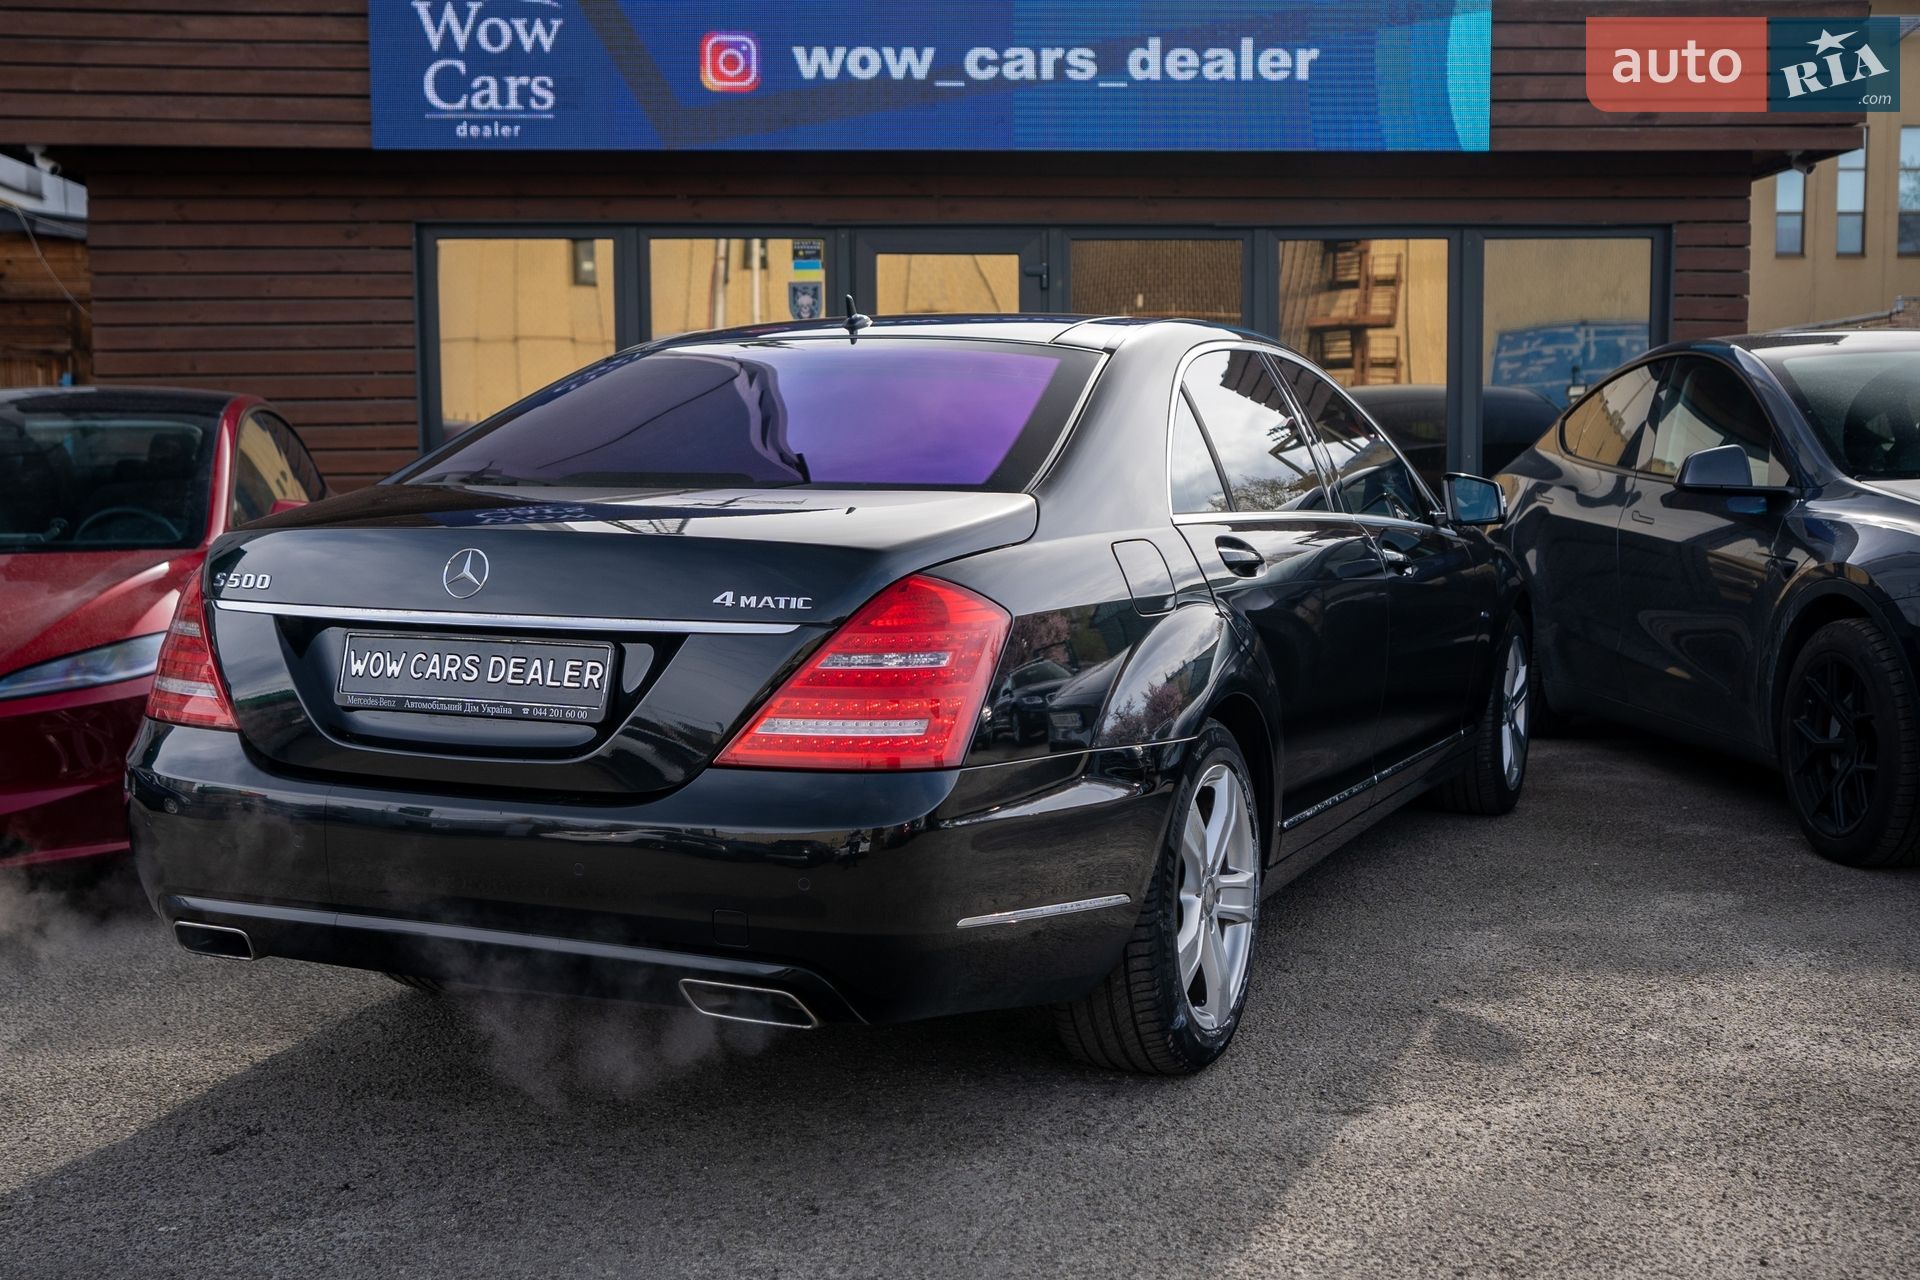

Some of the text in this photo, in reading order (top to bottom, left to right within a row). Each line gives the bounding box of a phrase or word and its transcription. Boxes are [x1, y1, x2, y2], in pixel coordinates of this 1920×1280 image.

[411, 1, 563, 53] Wow
[792, 36, 1320, 88] wow_cars_dealer
[422, 59, 556, 112] Cars
[455, 120, 522, 138] dealer
[349, 649, 604, 690] WOW CARS DEALER
[346, 695, 397, 708] Mercedes-Benz
[463, 702, 479, 714] Дім
[481, 703, 513, 716] Україна
[532, 707, 547, 717] 044
[549, 708, 563, 718] 201
[565, 709, 576, 719] 60
[577, 710, 588, 720] 00
